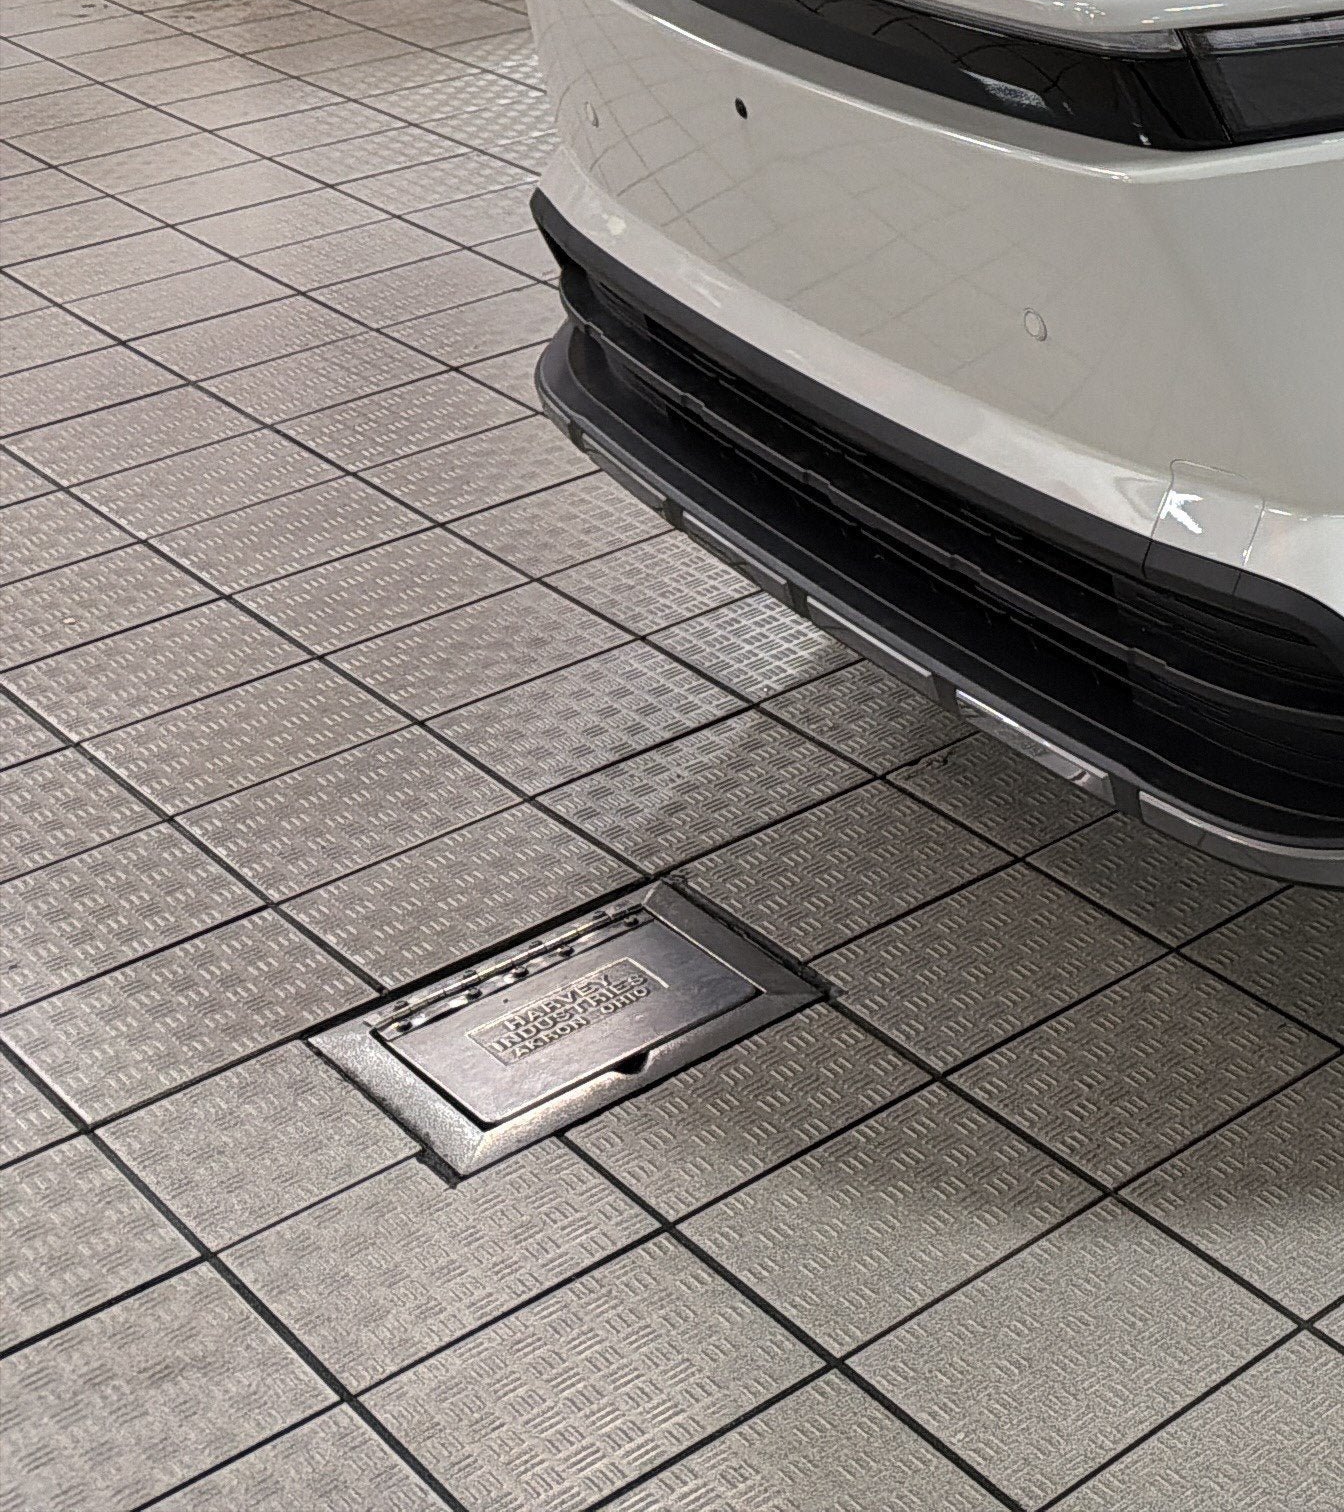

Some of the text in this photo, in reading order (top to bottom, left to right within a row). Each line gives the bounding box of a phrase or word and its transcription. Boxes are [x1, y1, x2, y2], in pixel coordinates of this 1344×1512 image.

[489, 973, 648, 1054] INDUSTRIES
[502, 973, 614, 1032] HARVEY
[513, 987, 650, 1059] AKRON OHIO
